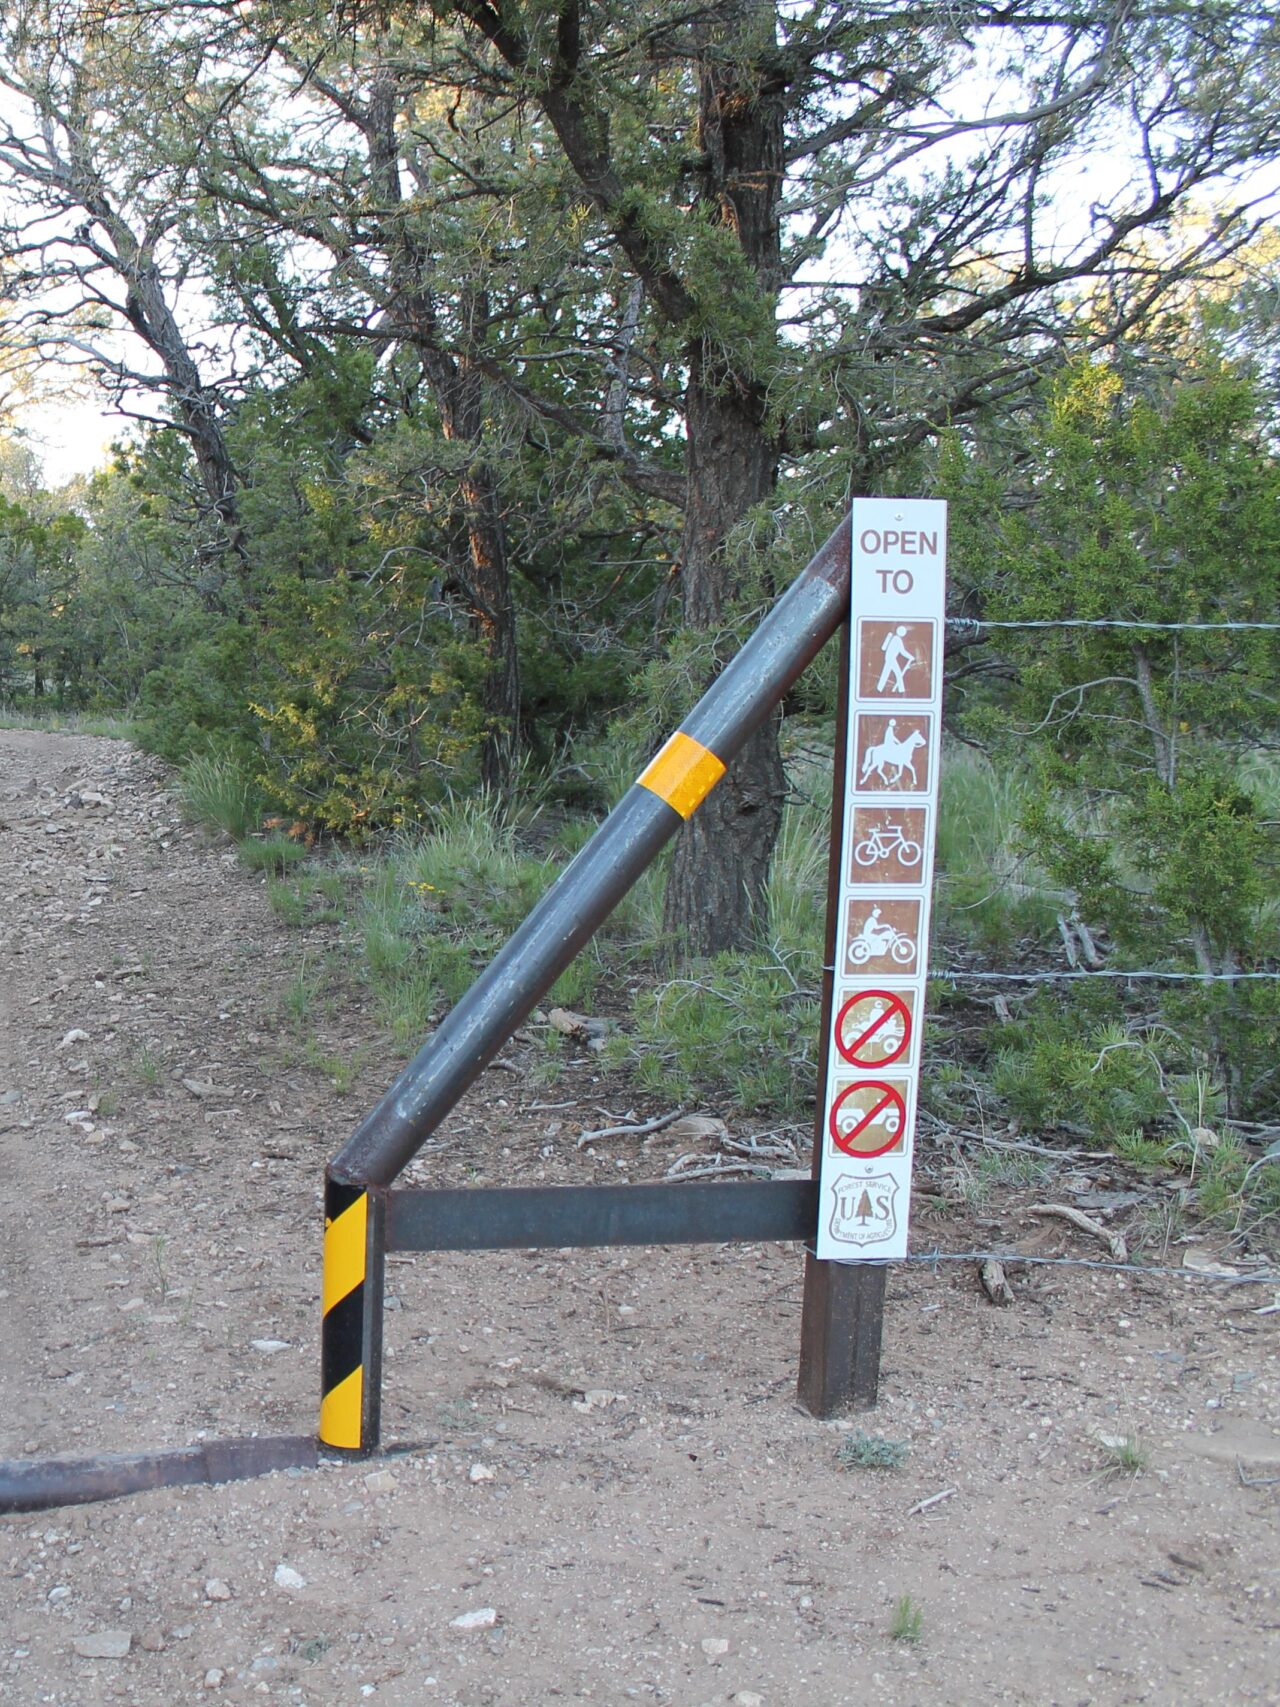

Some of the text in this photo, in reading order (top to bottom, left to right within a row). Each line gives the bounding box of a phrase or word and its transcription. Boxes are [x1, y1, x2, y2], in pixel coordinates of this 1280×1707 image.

[860, 529, 937, 555] OPEN
[875, 569, 914, 594] TO
[838, 1181, 892, 1194] FOREST SERVICE
[840, 1195, 890, 1221] U S
